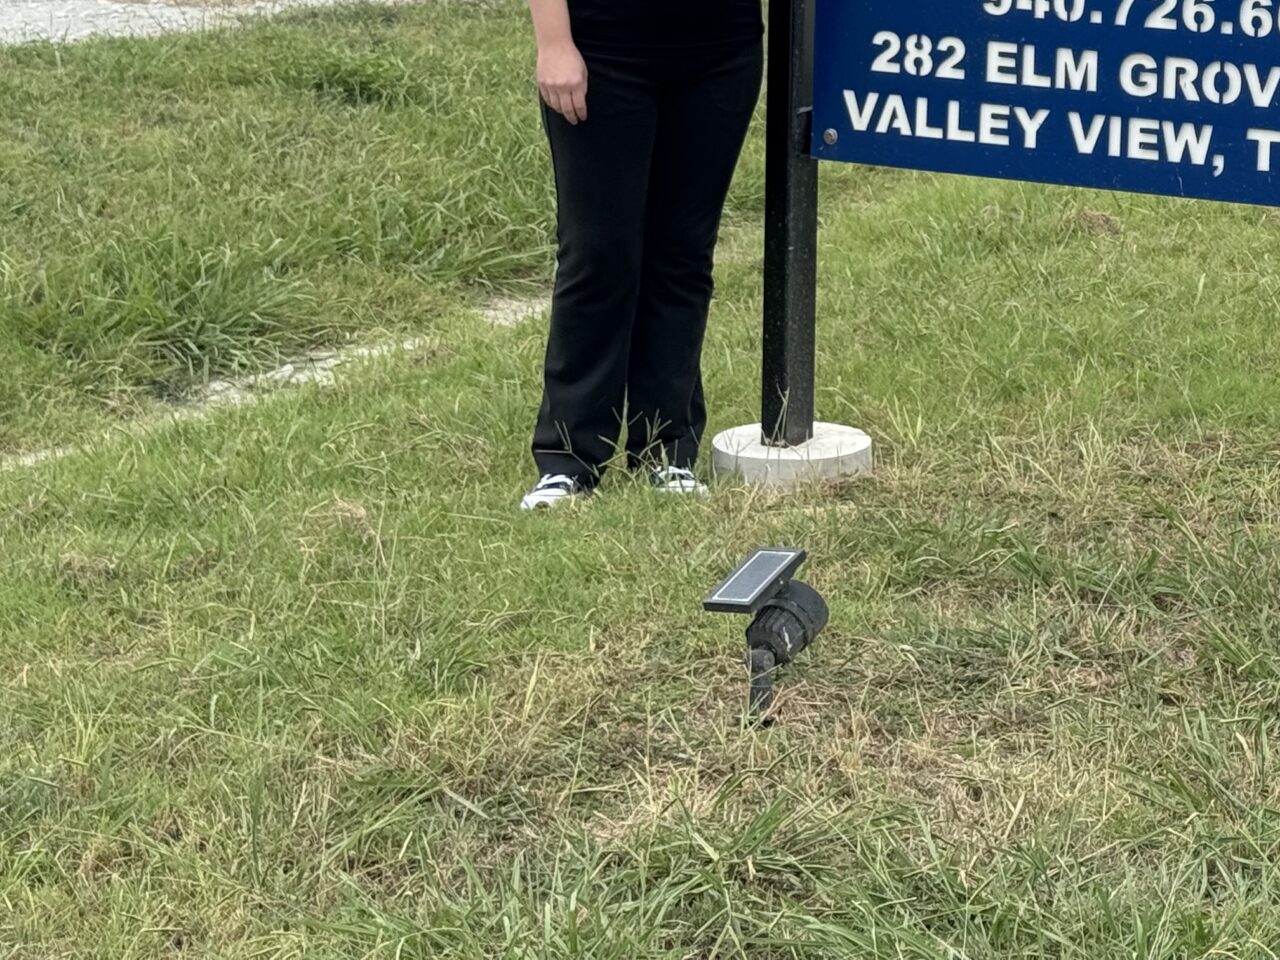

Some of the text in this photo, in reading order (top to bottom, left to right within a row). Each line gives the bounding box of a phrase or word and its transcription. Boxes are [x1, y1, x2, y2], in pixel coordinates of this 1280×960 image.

[871, 31, 966, 80] 282
[986, 41, 1098, 92] ELM
[843, 89, 1050, 149] VALLEY
[1068, 111, 1225, 177] VIEW,
